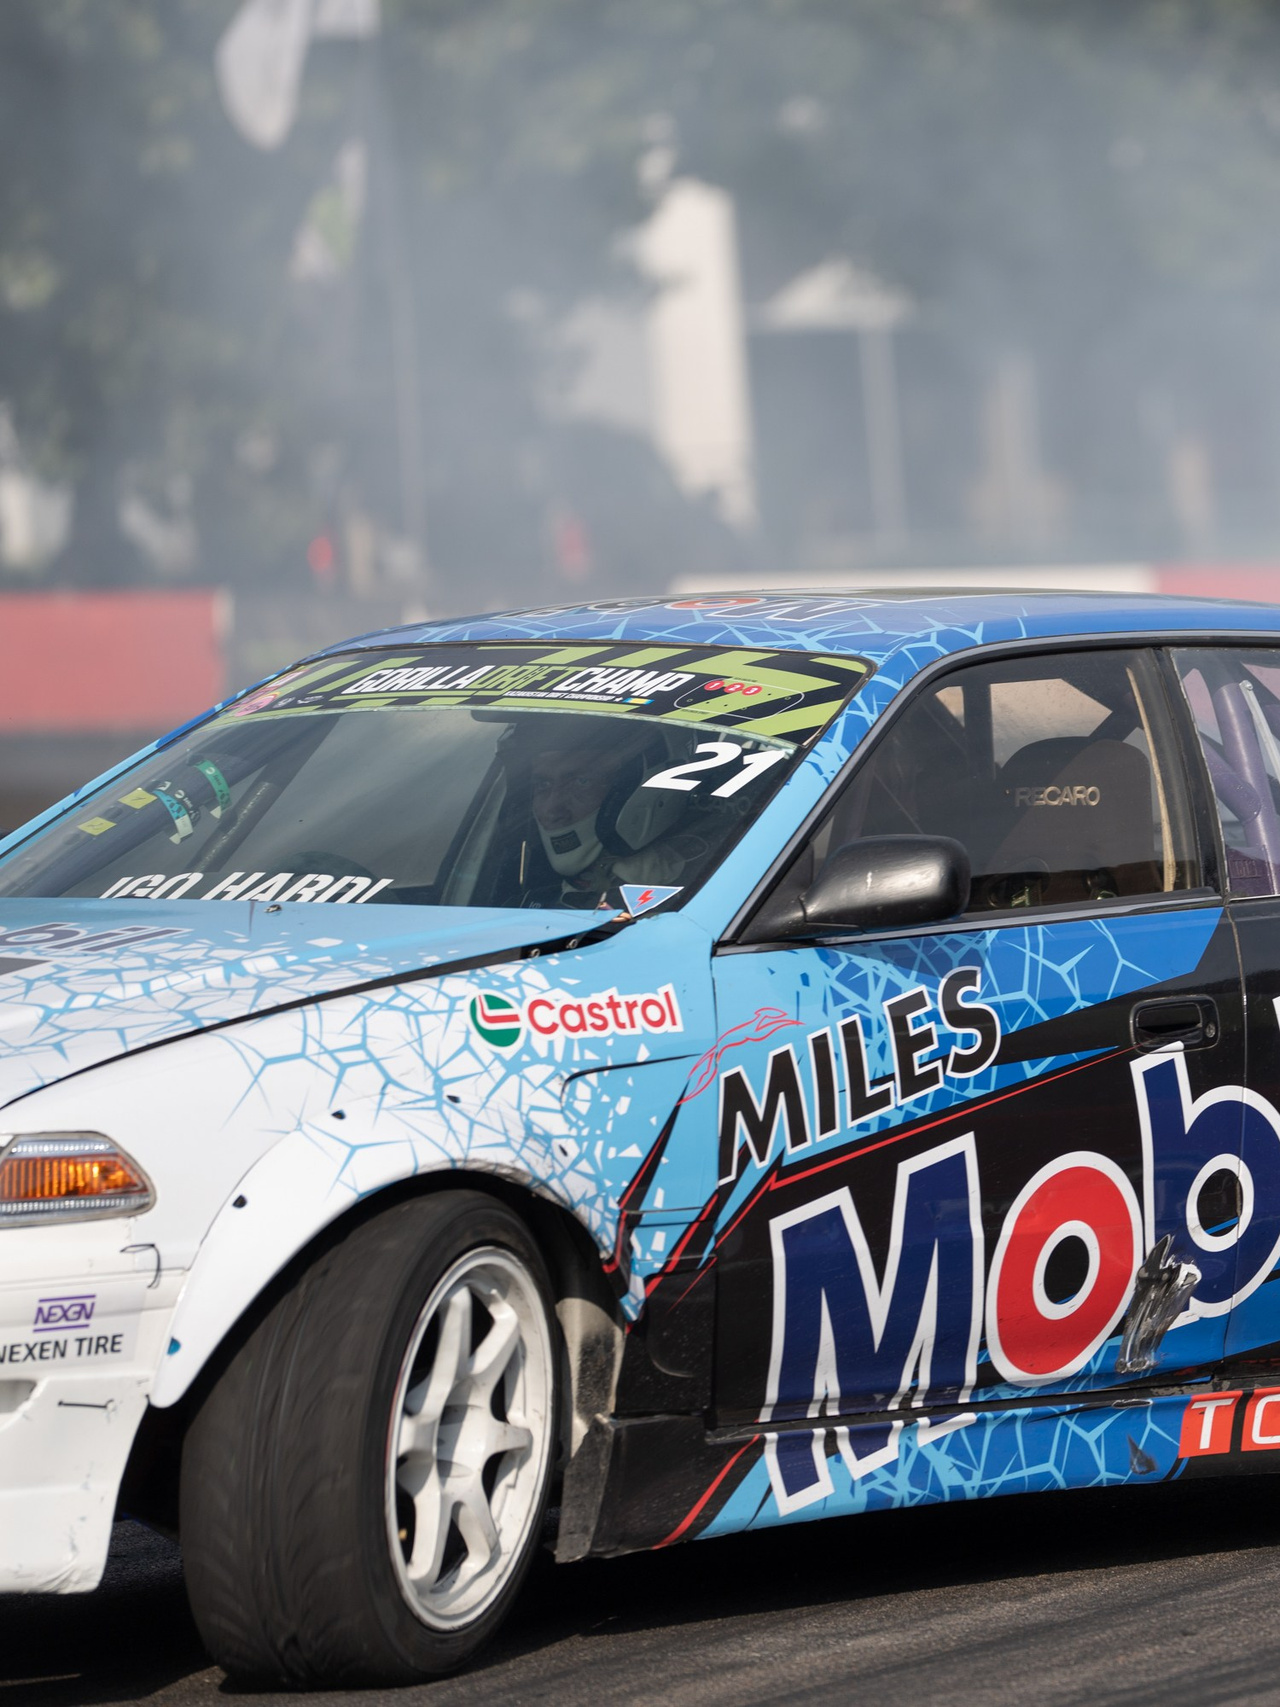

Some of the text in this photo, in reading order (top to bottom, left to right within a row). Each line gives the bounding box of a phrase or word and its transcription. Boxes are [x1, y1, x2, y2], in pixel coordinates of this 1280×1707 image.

[640, 742, 788, 799] 21
[1015, 785, 1101, 807] RECARO
[0, 912, 194, 952] bil
[527, 990, 678, 1037] Castrol
[717, 965, 1001, 1187] MILES
[74, 1333, 124, 1357] TIRE
